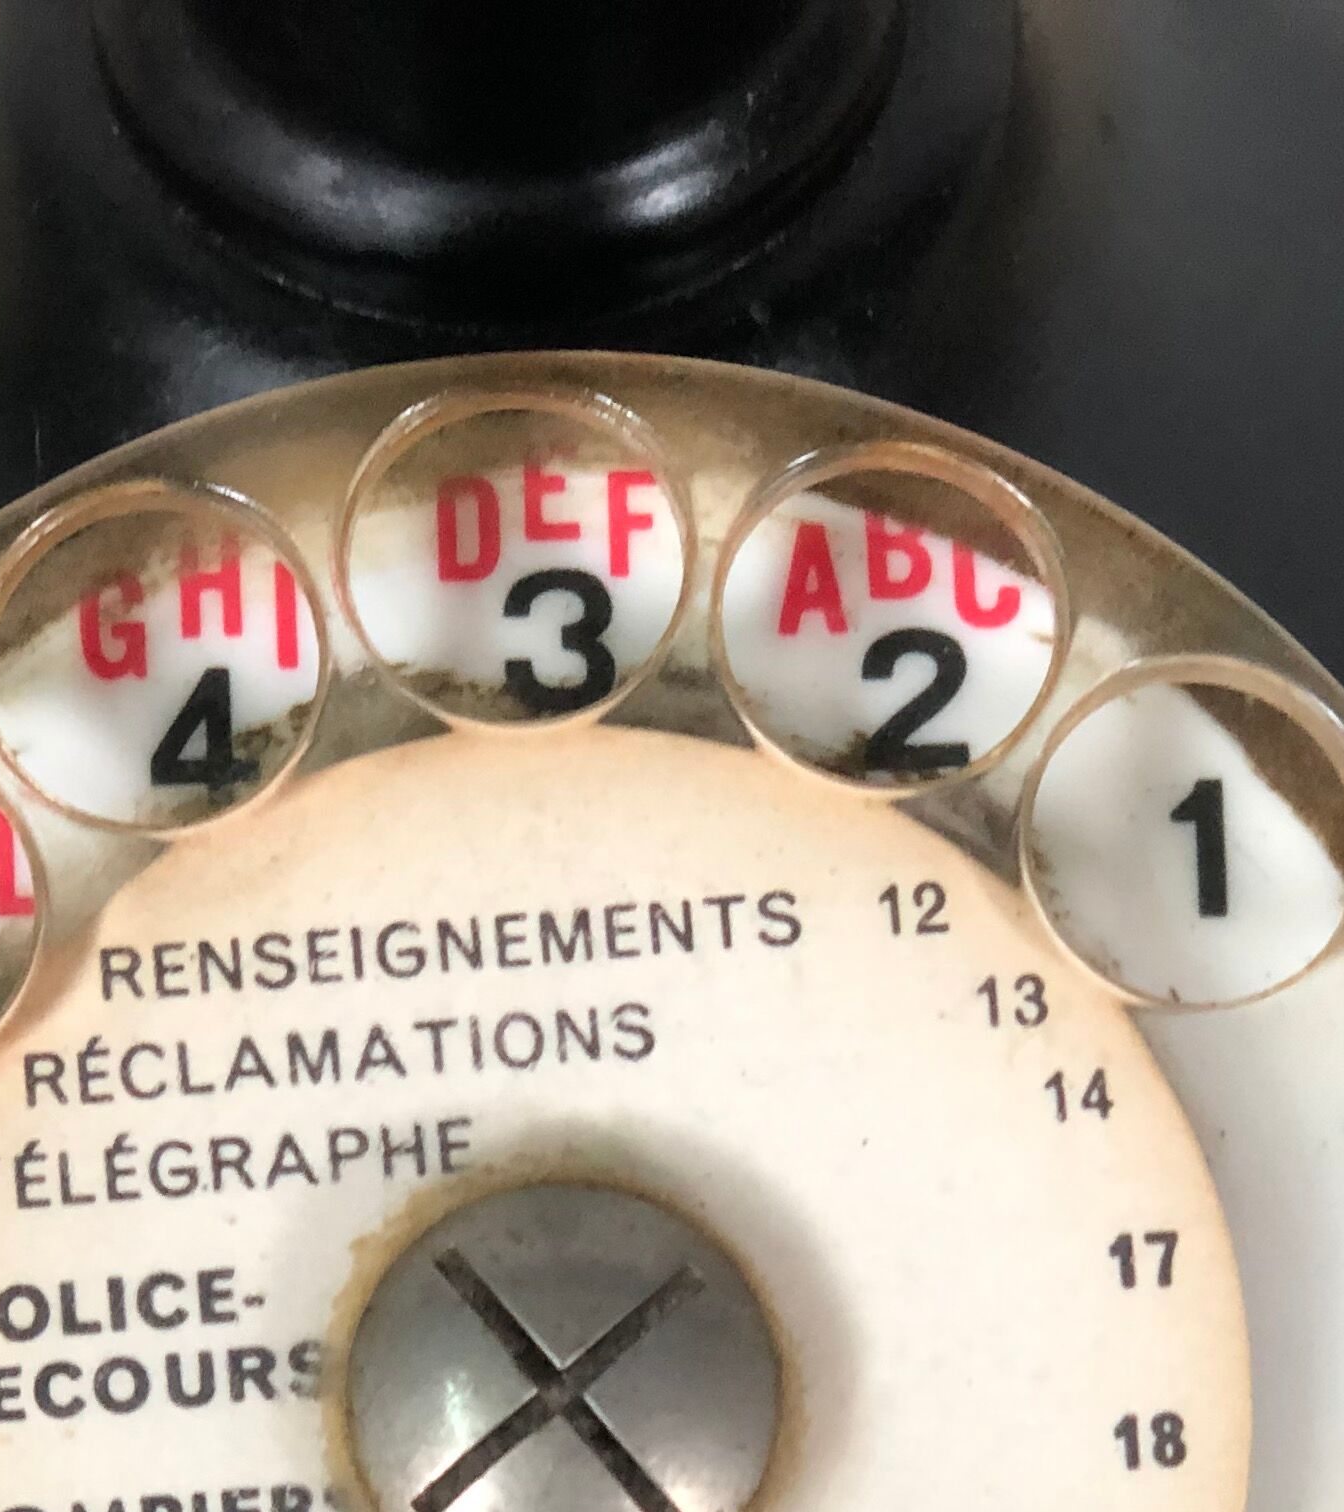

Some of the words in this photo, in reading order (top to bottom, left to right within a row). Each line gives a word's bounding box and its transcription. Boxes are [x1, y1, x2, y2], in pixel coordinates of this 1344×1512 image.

[436, 450, 654, 582] DEF
[777, 508, 1020, 637] ABC
[78, 532, 298, 682] GHI
[502, 569, 616, 711] 3
[150, 667, 261, 792] 4
[861, 627, 971, 771] 2
[1170, 778, 1228, 919] 1
[99, 890, 803, 1001] RENSEIGNEMENTS
[878, 881, 950, 936] 12
[23, 1001, 656, 1107] RÉCLAMATIONS
[976, 972, 1050, 1029] 13
[1043, 1067, 1114, 1122] 14
[1108, 1229, 1180, 1288] 17
[1112, 1410, 1188, 1470] 18
